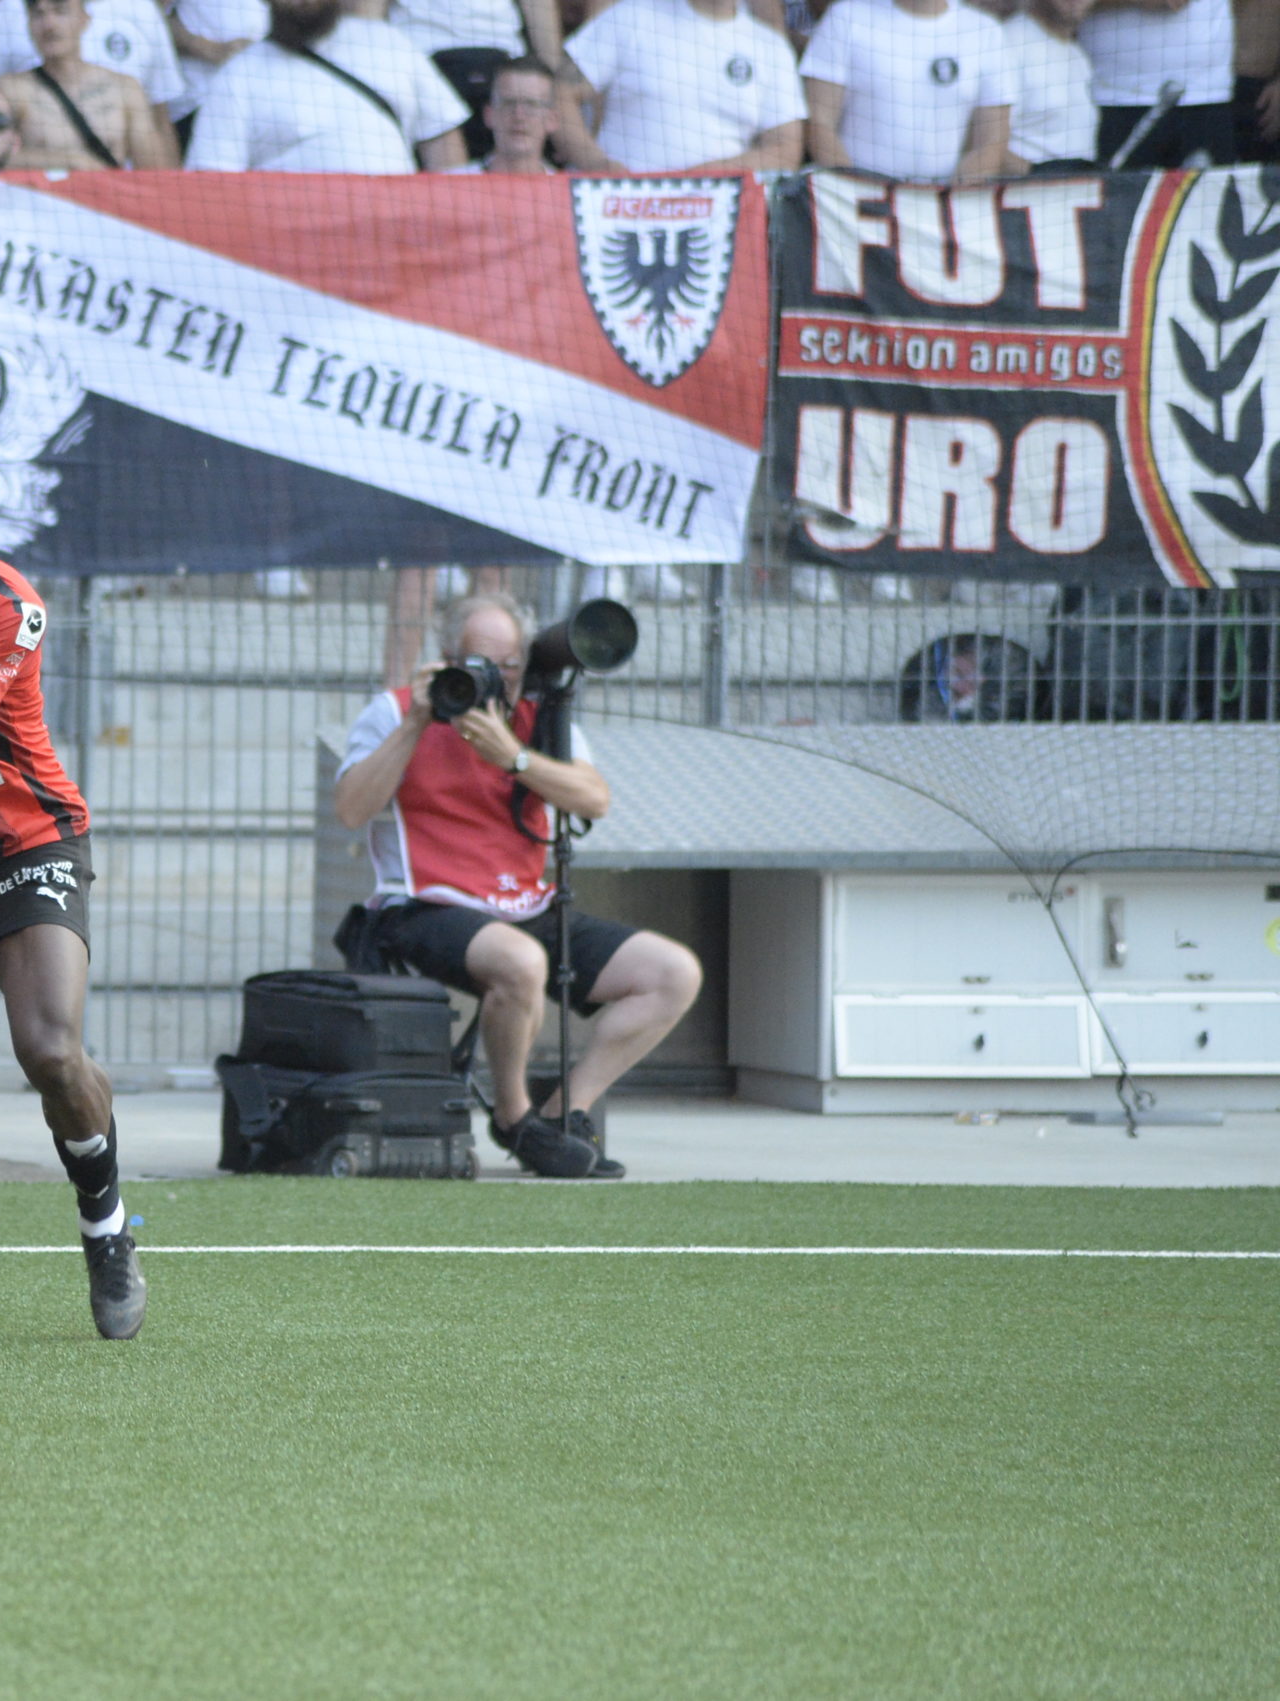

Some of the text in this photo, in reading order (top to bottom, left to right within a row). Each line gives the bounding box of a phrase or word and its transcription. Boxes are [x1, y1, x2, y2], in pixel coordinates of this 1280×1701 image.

[807, 168, 1104, 312] FUT
[799, 325, 1124, 382] sektion amigos
[269, 336, 522, 470] TEQUILA
[537, 424, 717, 540] FRONT
[794, 403, 1110, 554] URO
